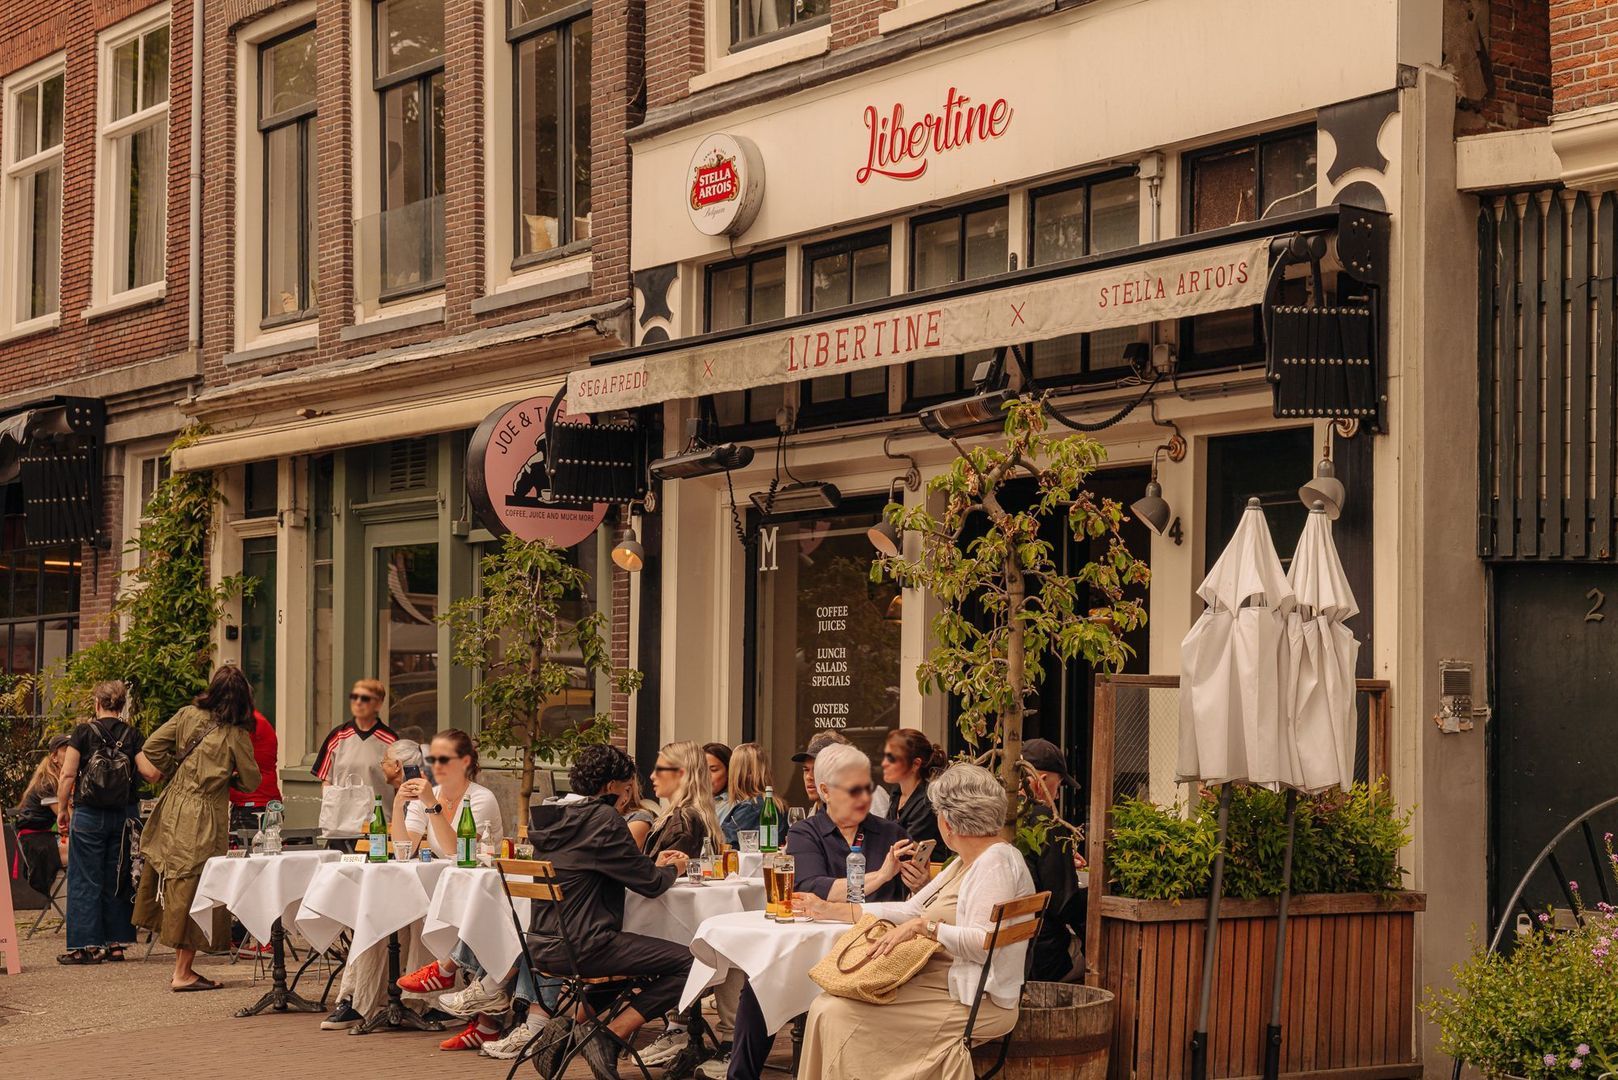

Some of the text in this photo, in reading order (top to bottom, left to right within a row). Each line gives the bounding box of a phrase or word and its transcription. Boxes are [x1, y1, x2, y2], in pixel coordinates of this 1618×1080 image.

[856, 87, 1014, 183] Libertine
[699, 168, 731, 187] STELLA
[699, 180, 732, 199] ARTOIS
[578, 370, 649, 398] SEGAFREDO
[787, 309, 943, 373] LIBERTINE
[1098, 277, 1167, 308] STELLA
[1176, 261, 1249, 297] ARTOIS
[495, 406, 565, 455] JOE & TE
[505, 509, 594, 522] COFFEE, JUICE AND MUCH MORE
[1168, 516, 1184, 546] 4
[759, 526, 779, 571] M
[816, 605, 849, 618] COFFEE
[1584, 587, 1605, 622] 2
[278, 609, 283, 625] 5
[818, 619, 846, 634] JUICES
[817, 647, 846, 659] LUNCH
[815, 661, 848, 673] SALADS
[811, 675, 851, 687] SPECIALS
[812, 703, 849, 715] OYSTERS
[814, 717, 847, 728] SNACKS
